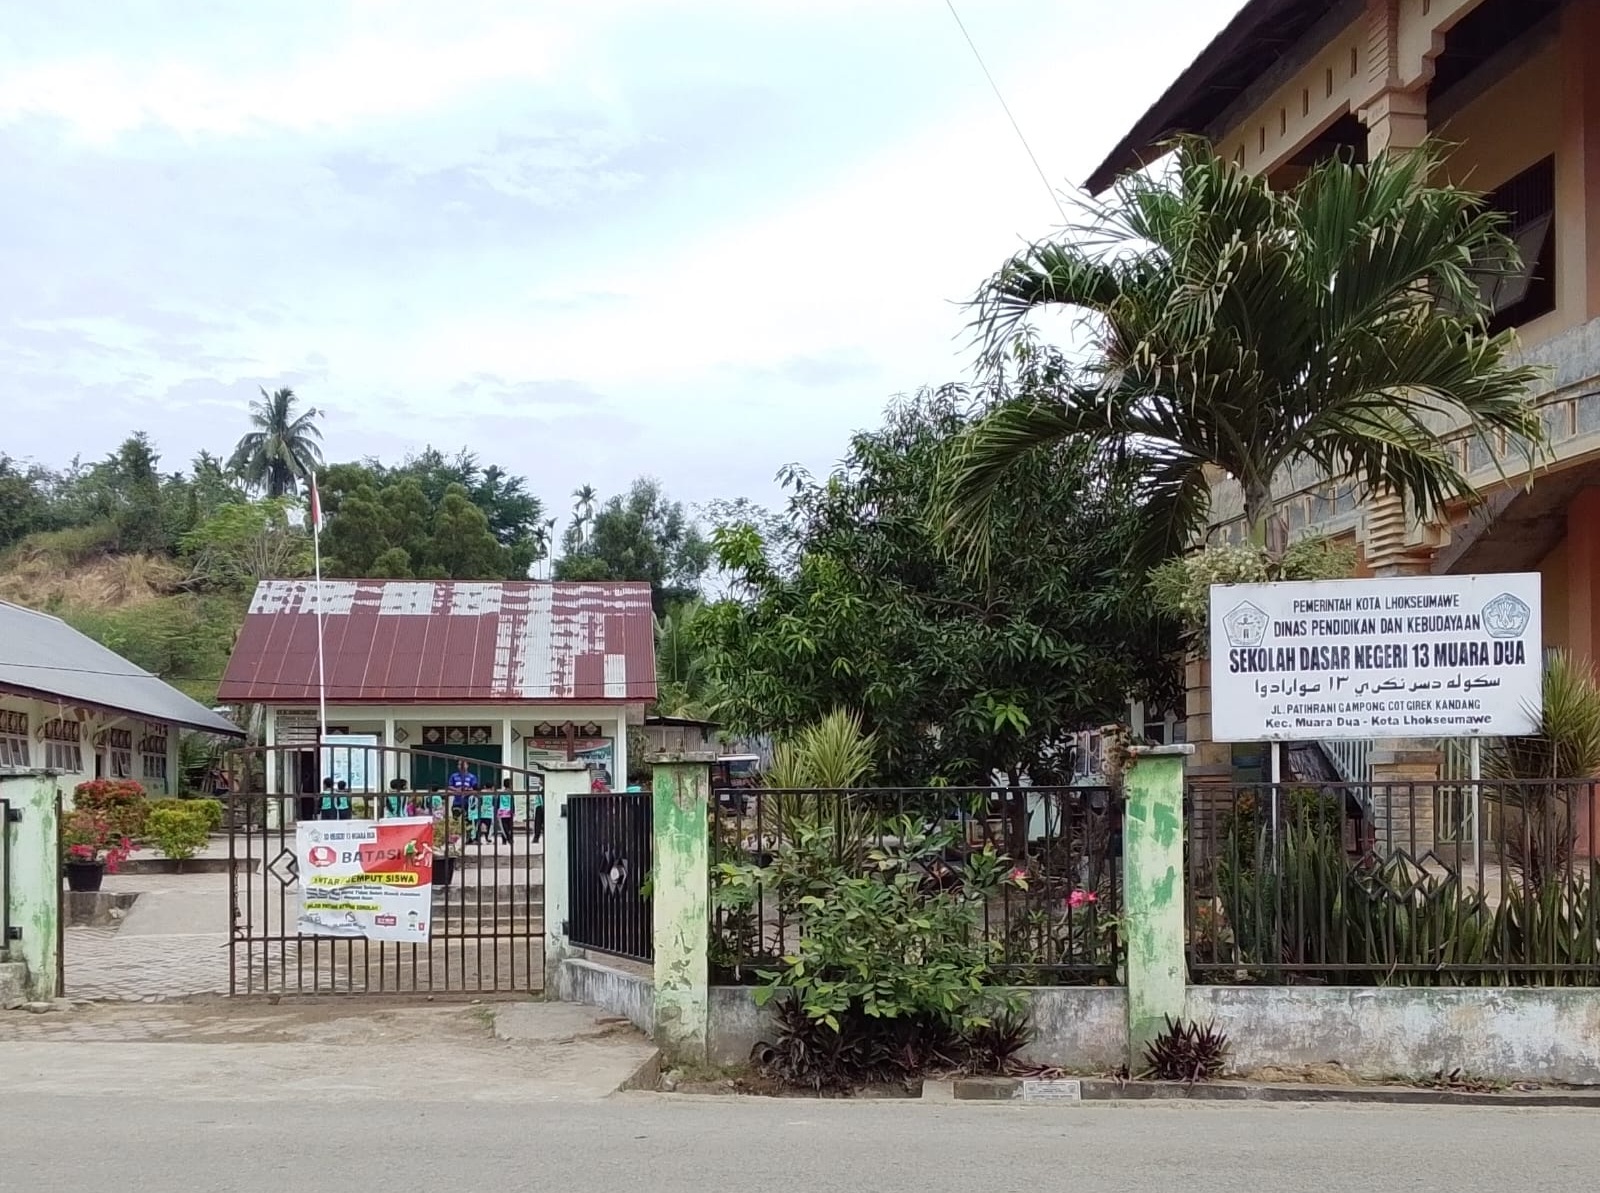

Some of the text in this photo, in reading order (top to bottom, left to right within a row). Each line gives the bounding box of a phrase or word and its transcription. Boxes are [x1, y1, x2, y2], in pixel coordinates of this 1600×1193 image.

[1293, 594, 1460, 613] PEMERINTAH KOTA LHOKSEUMAWE
[1274, 614, 1480, 637] DINAS PENDIDIKAN DAN KEBUDAYAAN
[1229, 640, 1525, 673] SEKOLAH DASAR NEGERI 13 MUARA DUA
[1339, 701, 1385, 713] GAMPONG
[1435, 699, 1481, 710] KANDANG
[1265, 718, 1292, 728] Kec.
[1295, 717, 1333, 728] Muara
[1371, 715, 1400, 726] Kota
[1403, 714, 1492, 726] Lhokseumawe
[385, 874, 415, 883] SISWA
